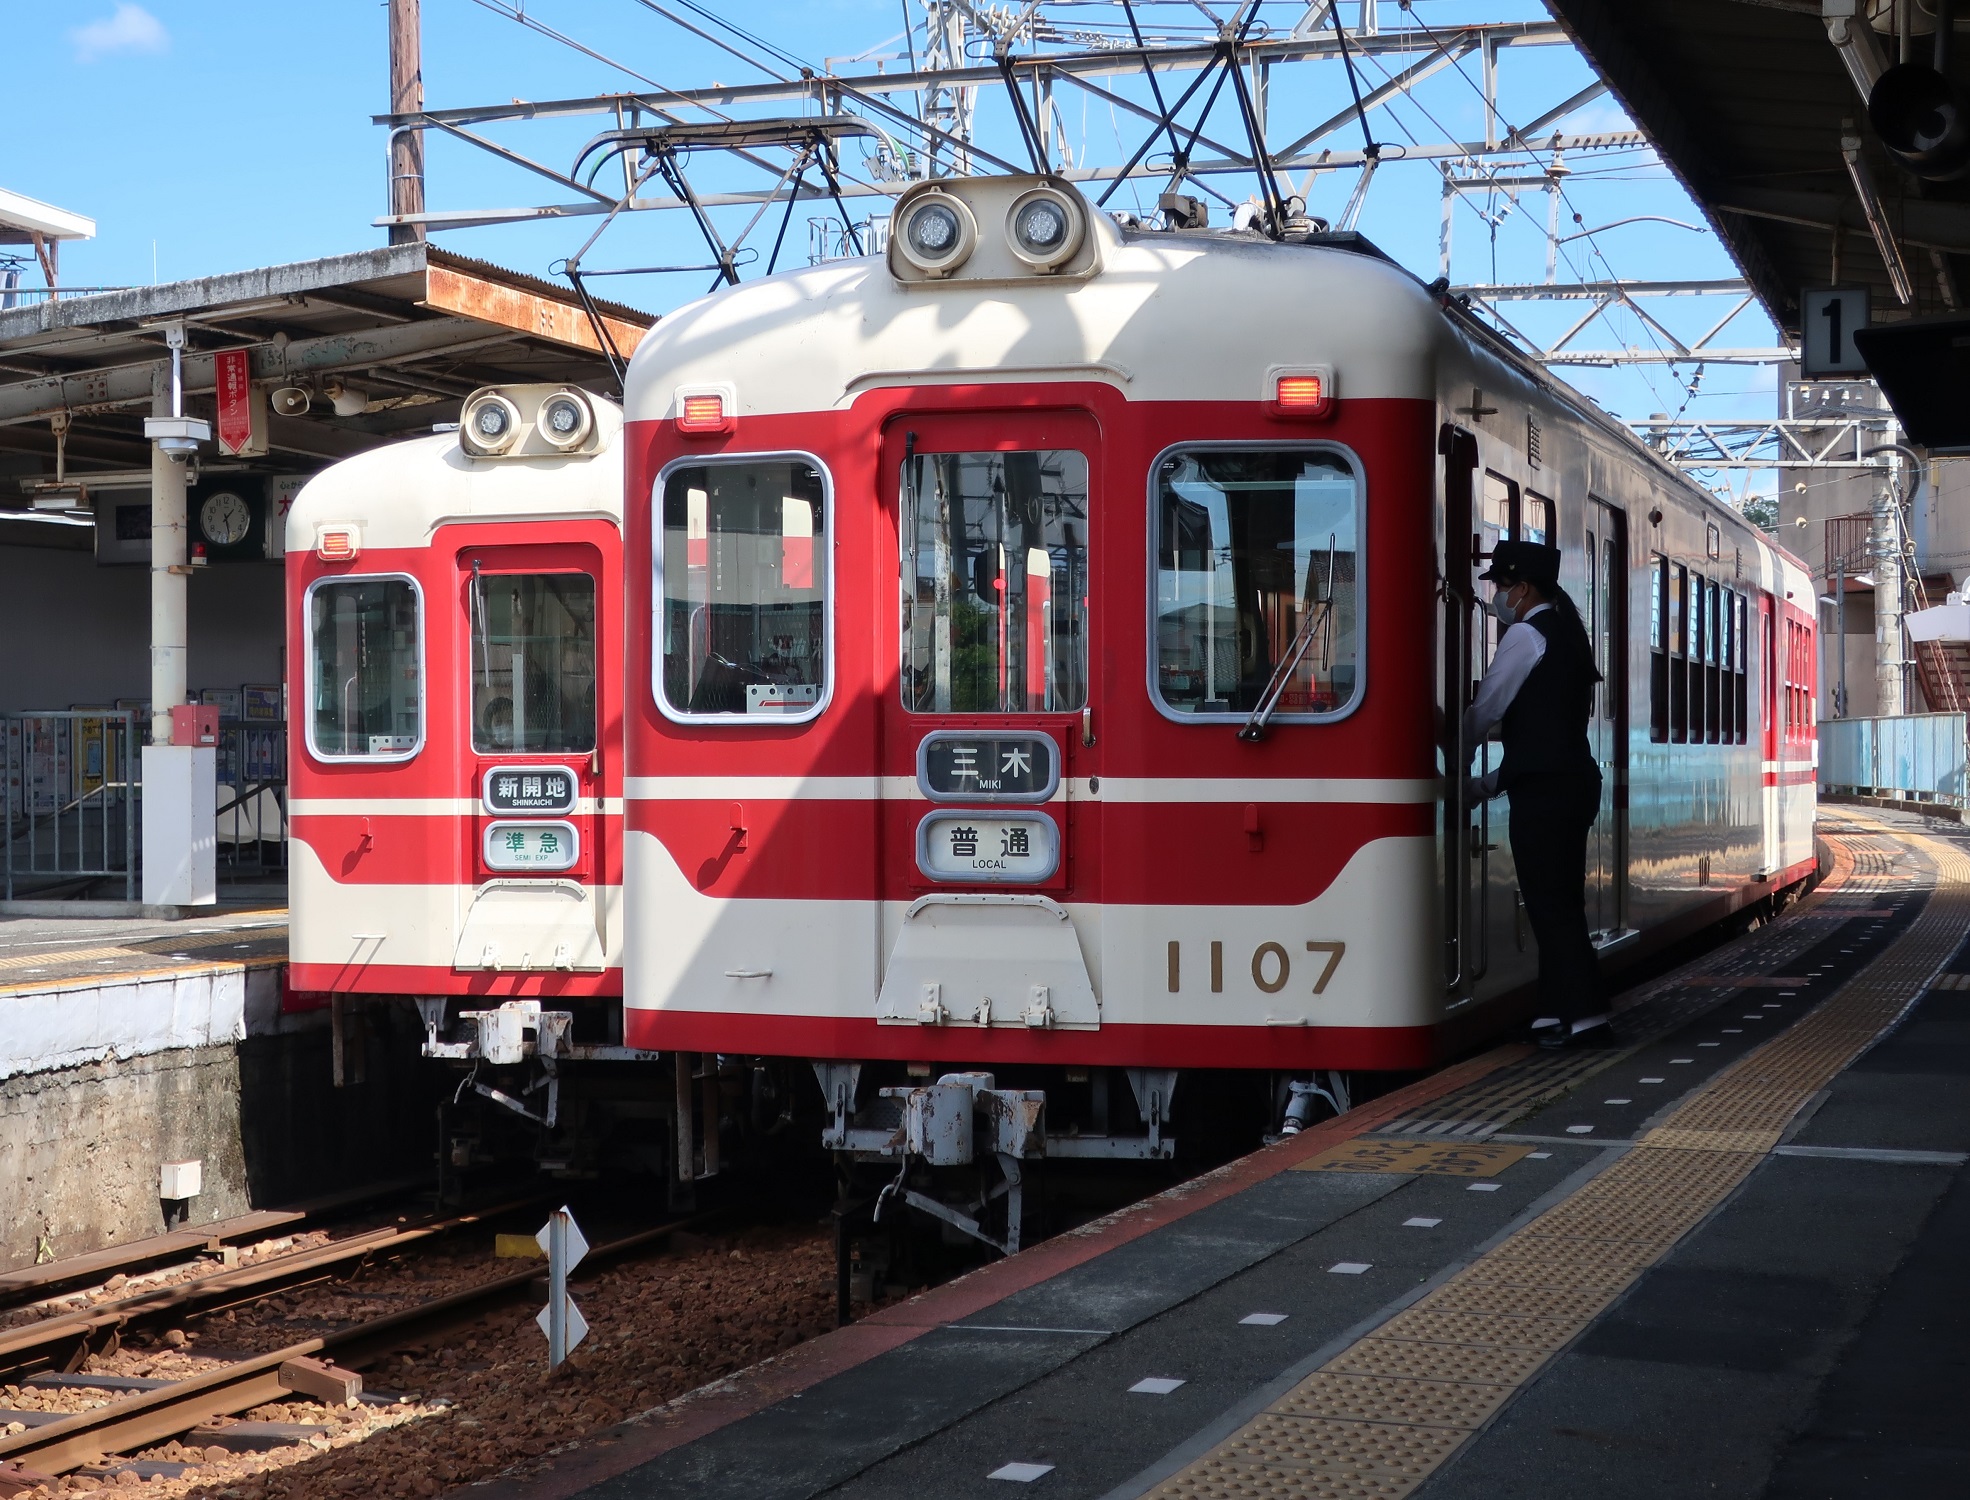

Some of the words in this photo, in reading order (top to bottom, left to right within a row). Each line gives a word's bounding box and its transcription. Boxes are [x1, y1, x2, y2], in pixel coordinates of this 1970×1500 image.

[1821, 298, 1841, 364] 1
[226, 356, 238, 416] 非常通報ボタン
[279, 480, 307, 490] 心とから
[278, 494, 292, 516] 大
[951, 747, 1031, 778] 三木
[498, 776, 566, 798] 新開地
[979, 779, 1001, 789] MIKI
[512, 798, 553, 806] SHINKAICHI
[505, 832, 559, 853] 準急
[950, 826, 1030, 858] 普通
[972, 859, 1007, 869] LOCAL
[1167, 939, 1346, 995] 1107
